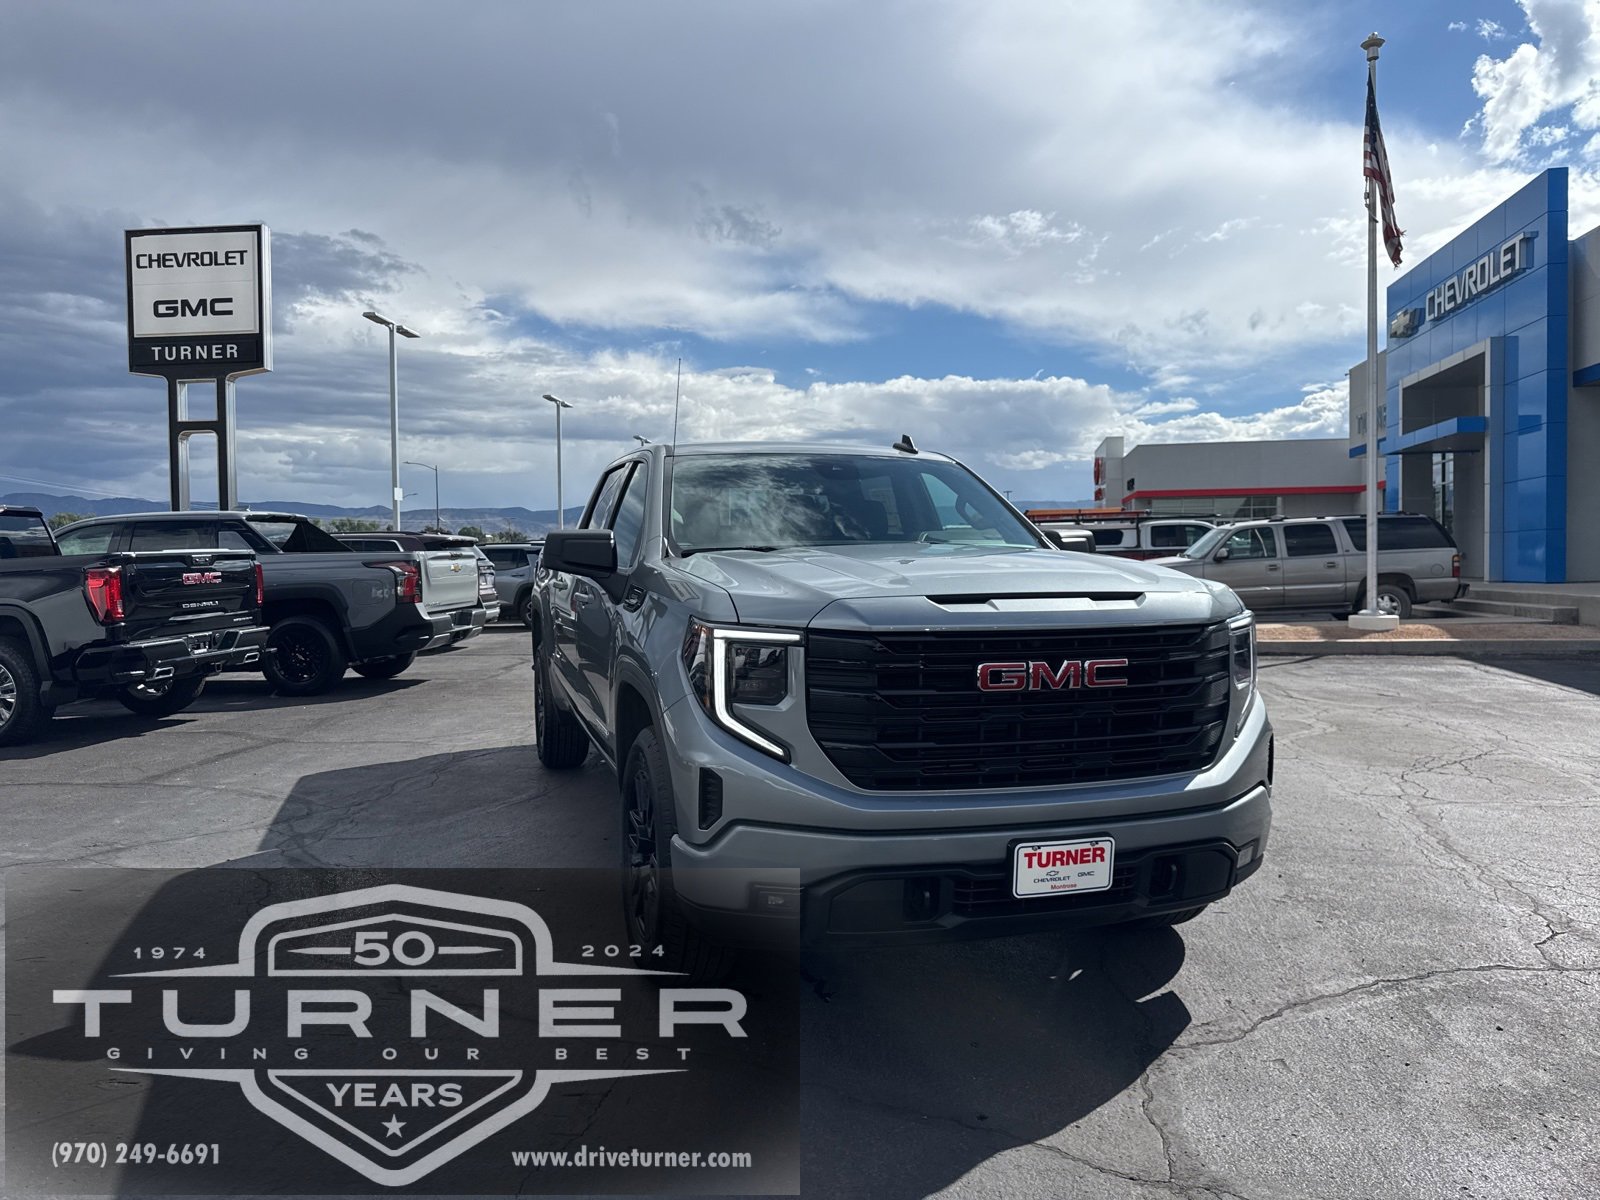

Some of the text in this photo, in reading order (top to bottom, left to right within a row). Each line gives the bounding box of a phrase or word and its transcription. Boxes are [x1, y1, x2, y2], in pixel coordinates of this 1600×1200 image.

[136, 250, 248, 269] CHEVROLET
[1425, 231, 1529, 322] CHEVROLET
[153, 297, 233, 318] GMC
[151, 344, 238, 361] TURNER
[182, 571, 222, 585] GMC
[977, 658, 1128, 692] GMC
[1024, 846, 1106, 869] TURNER
[1033, 876, 1071, 884] CHEVROLET
[1077, 870, 1096, 878] GMC
[1050, 882, 1078, 891] Montrose
